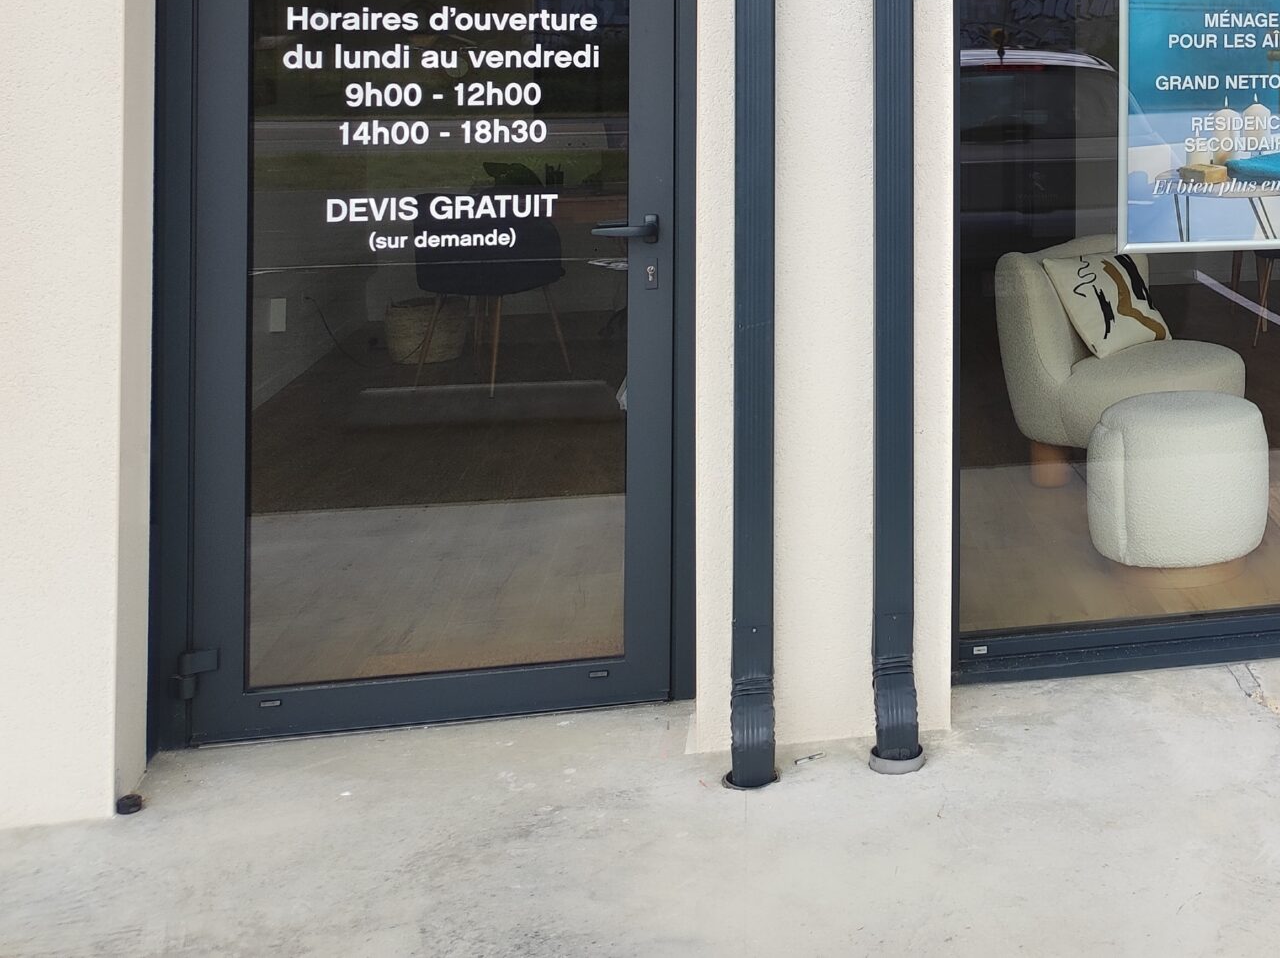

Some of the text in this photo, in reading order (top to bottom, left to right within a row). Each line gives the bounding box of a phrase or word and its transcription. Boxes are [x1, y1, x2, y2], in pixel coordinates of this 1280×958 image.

[286, 6, 599, 31] Horaires d'ouverture
[1204, 9, 1279, 28] MÉNAGE
[1168, 34, 1218, 49] POUR
[1223, 33, 1256, 48] LES
[283, 44, 600, 69] du lundi au vendredi
[345, 82, 422, 107] 9h00
[454, 82, 542, 107] 12h00
[1155, 75, 1219, 91] GRAND
[338, 120, 429, 145] 14h00
[461, 119, 547, 144] 18h30
[1152, 179, 1171, 195] Et
[1178, 179, 1210, 193] bien
[1218, 178, 1256, 196] plus
[326, 194, 558, 222] DEVIS GRATUIT
[369, 229, 516, 252] (sur demande)
